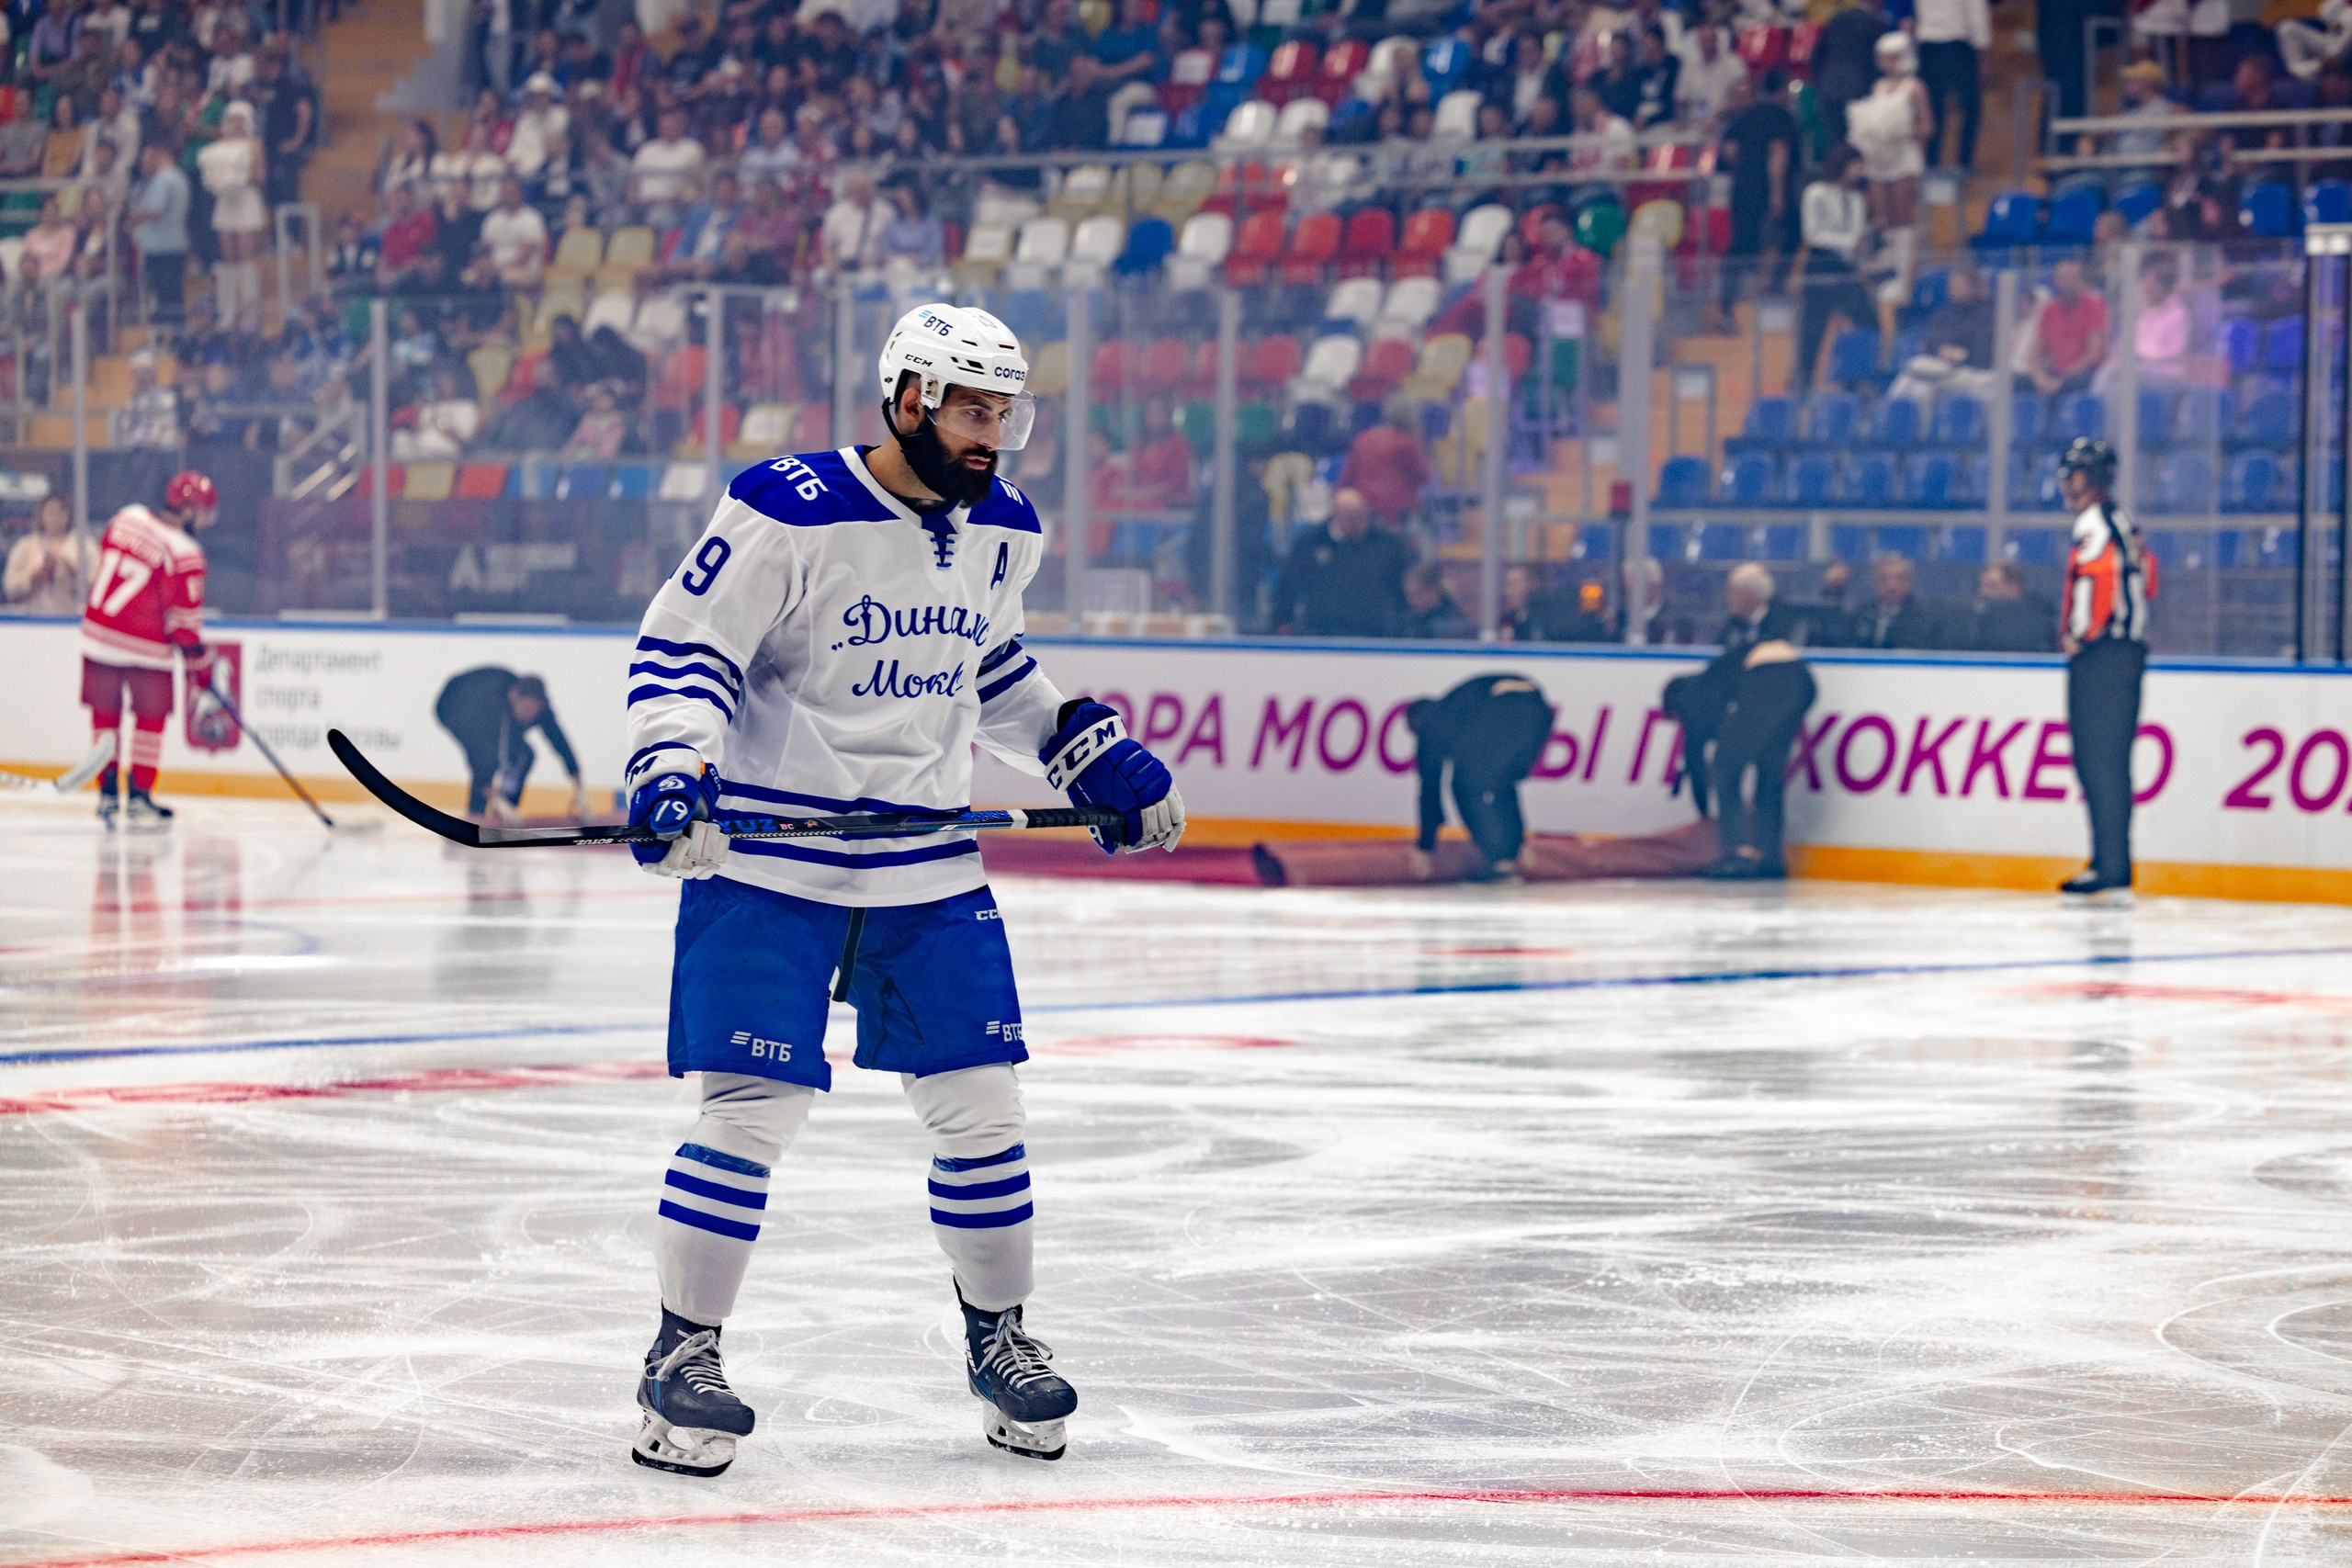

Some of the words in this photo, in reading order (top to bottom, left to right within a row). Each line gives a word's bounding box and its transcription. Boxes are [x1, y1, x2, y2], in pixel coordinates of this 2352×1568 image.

[923, 315, 953, 337] ВТБ
[905, 353, 933, 367] CCM
[994, 366, 1026, 381] согаз
[769, 457, 829, 501] ВТБ
[89, 547, 153, 618] 17
[669, 536, 731, 596] 9
[990, 541, 1009, 590] А
[1046, 720, 1116, 791] CCM
[1250, 695, 1612, 783] МОСЫ
[2223, 727, 2352, 812] 20
[654, 799, 689, 822] 19
[751, 1037, 793, 1063] ВТБ
